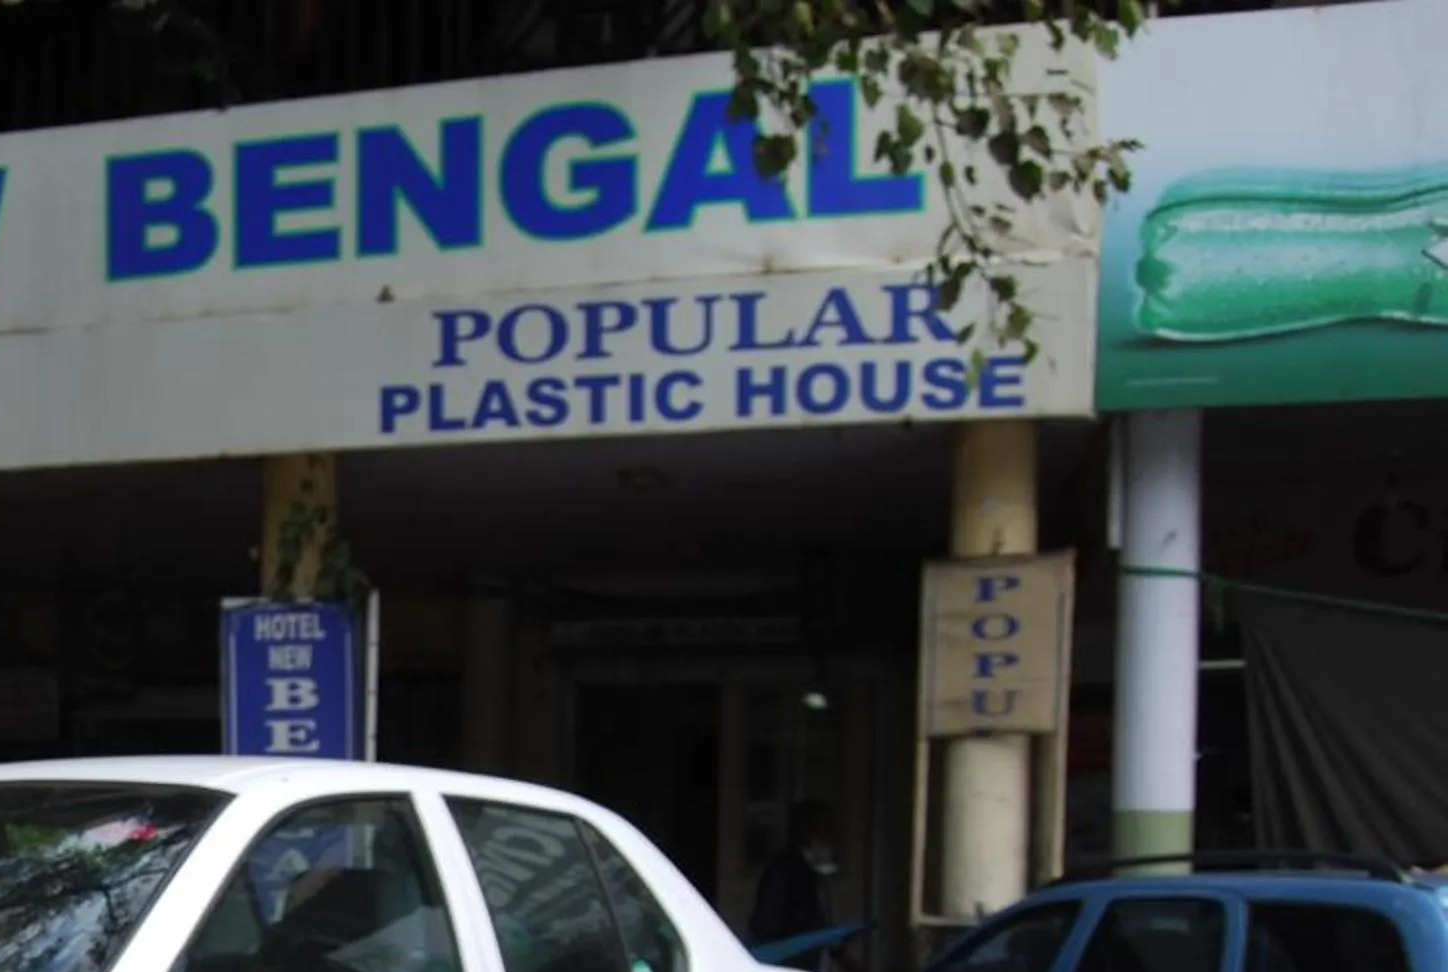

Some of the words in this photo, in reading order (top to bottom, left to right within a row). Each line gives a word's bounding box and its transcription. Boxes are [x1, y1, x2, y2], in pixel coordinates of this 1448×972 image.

[104, 76, 926, 284] BENGAL
[433, 283, 968, 368] POPULAR
[378, 371, 704, 434] PLASTIC
[734, 355, 1026, 418] HOUSE
[255, 613, 326, 641] HOTEL
